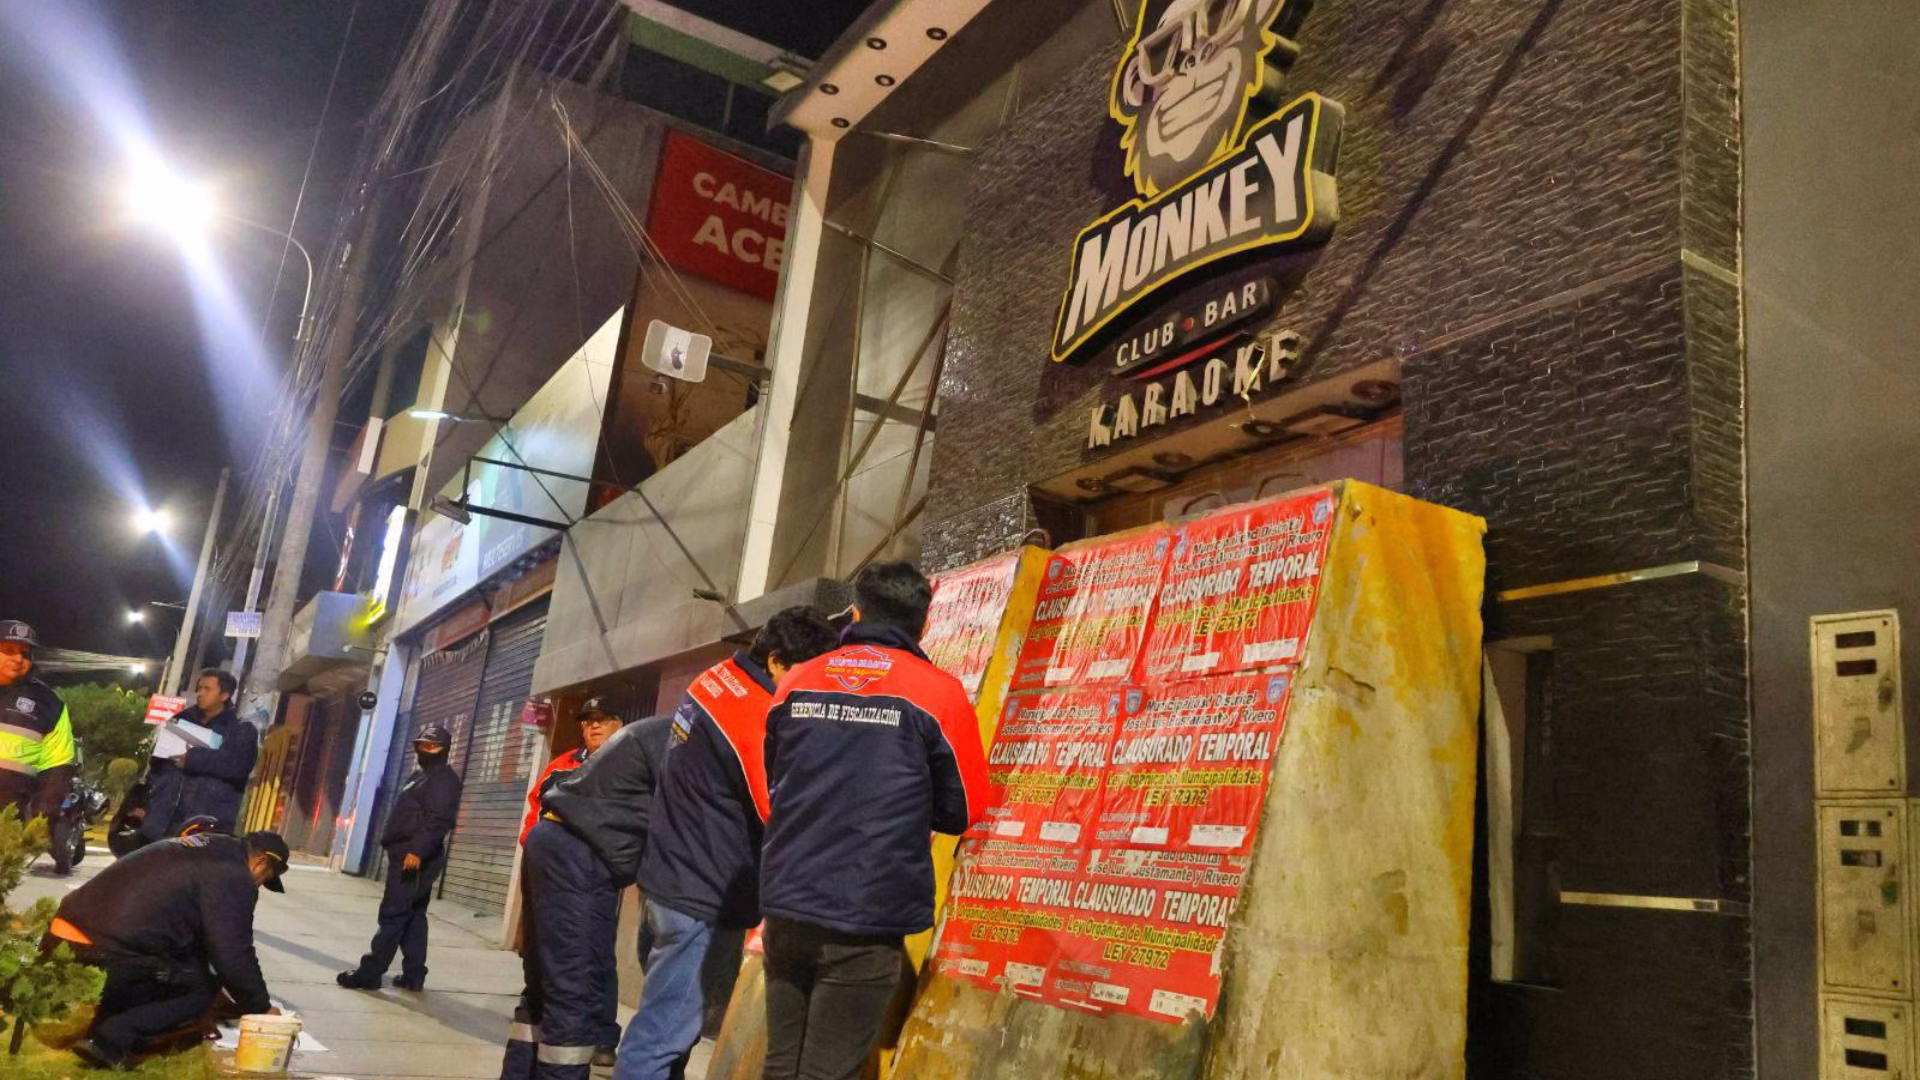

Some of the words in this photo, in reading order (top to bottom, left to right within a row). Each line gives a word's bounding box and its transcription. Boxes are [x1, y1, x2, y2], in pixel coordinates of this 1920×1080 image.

[692, 215, 785, 273] ACE
[1062, 113, 1304, 345] MONKEY
[1116, 321, 1174, 366] CLUB
[1204, 281, 1257, 327] BAR
[1088, 330, 1301, 449] KARAOKE
[1248, 549, 1319, 589] TEMPORAL
[791, 702, 826, 718] GERENCIA
[828, 704, 839, 719] DE
[840, 705, 902, 727] FISCALIZACIÓN
[1241, 709, 1276, 724] Rivero
[1111, 734, 1193, 766] CLAUSURADO
[1198, 731, 1272, 762] TEMPORAL
[1181, 767, 1263, 788] Municipalidades
[1144, 789, 1165, 806] LEY
[1016, 876, 1073, 907] TEMPORAL
[1110, 863, 1129, 876] Lui
[1193, 871, 1202, 886] y
[1204, 868, 1241, 887] Rivero
[1074, 881, 1157, 918] CLAUSURADO
[971, 923, 987, 940] LEY
[989, 925, 1021, 945] 27972
[1067, 914, 1084, 935] Ley
[1085, 917, 1126, 940] Orgánica
[1127, 925, 1141, 940] de
[1144, 925, 1218, 953] Municipalidade
[1103, 941, 1129, 963] LEY
[1130, 946, 1170, 971] 27972
